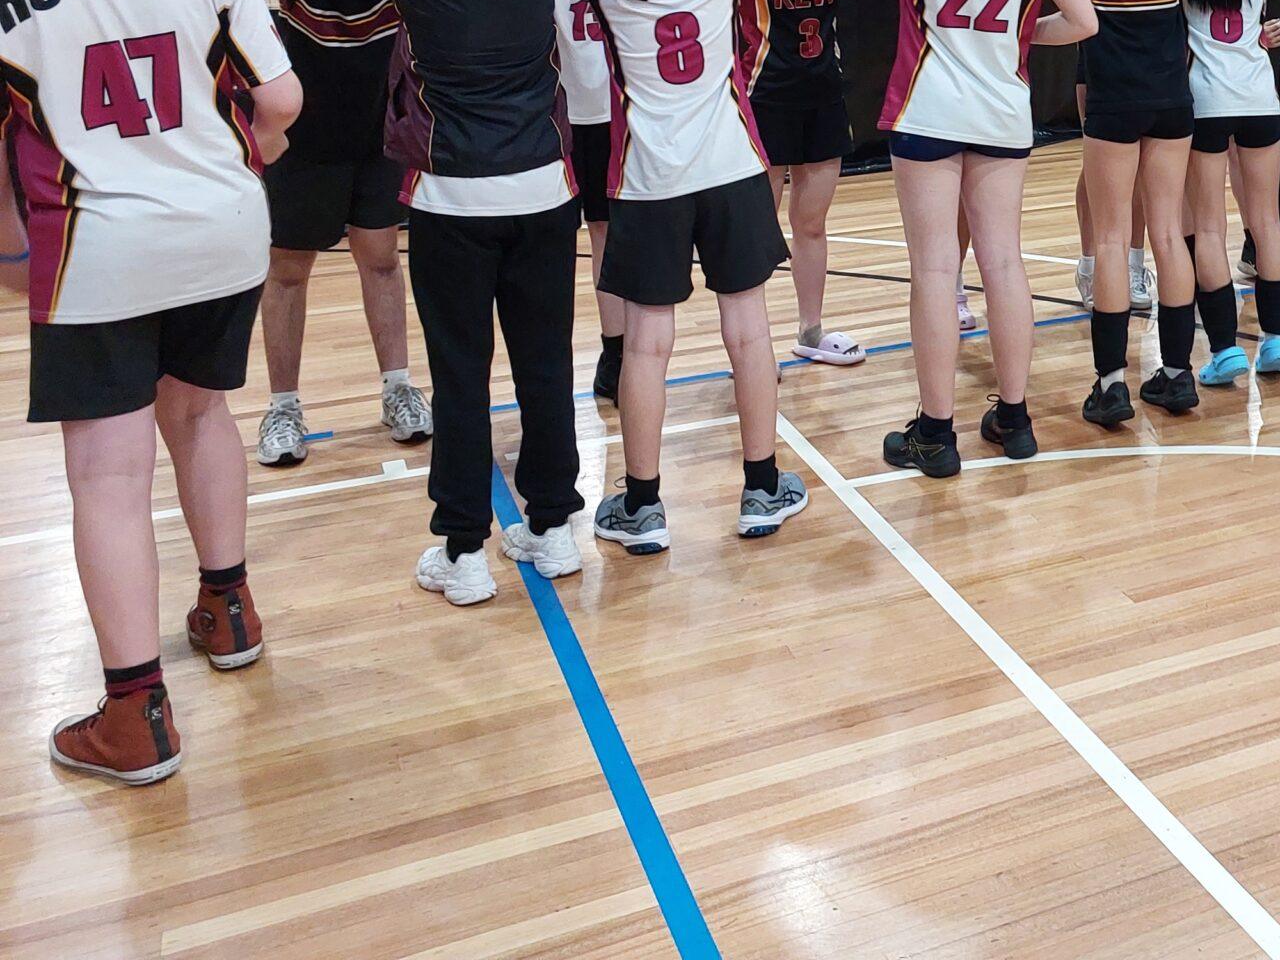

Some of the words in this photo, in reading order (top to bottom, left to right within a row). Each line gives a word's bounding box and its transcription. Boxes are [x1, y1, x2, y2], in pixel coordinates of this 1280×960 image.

[655, 11, 705, 85] 8
[799, 18, 824, 59] 3
[81, 30, 183, 139] 47
